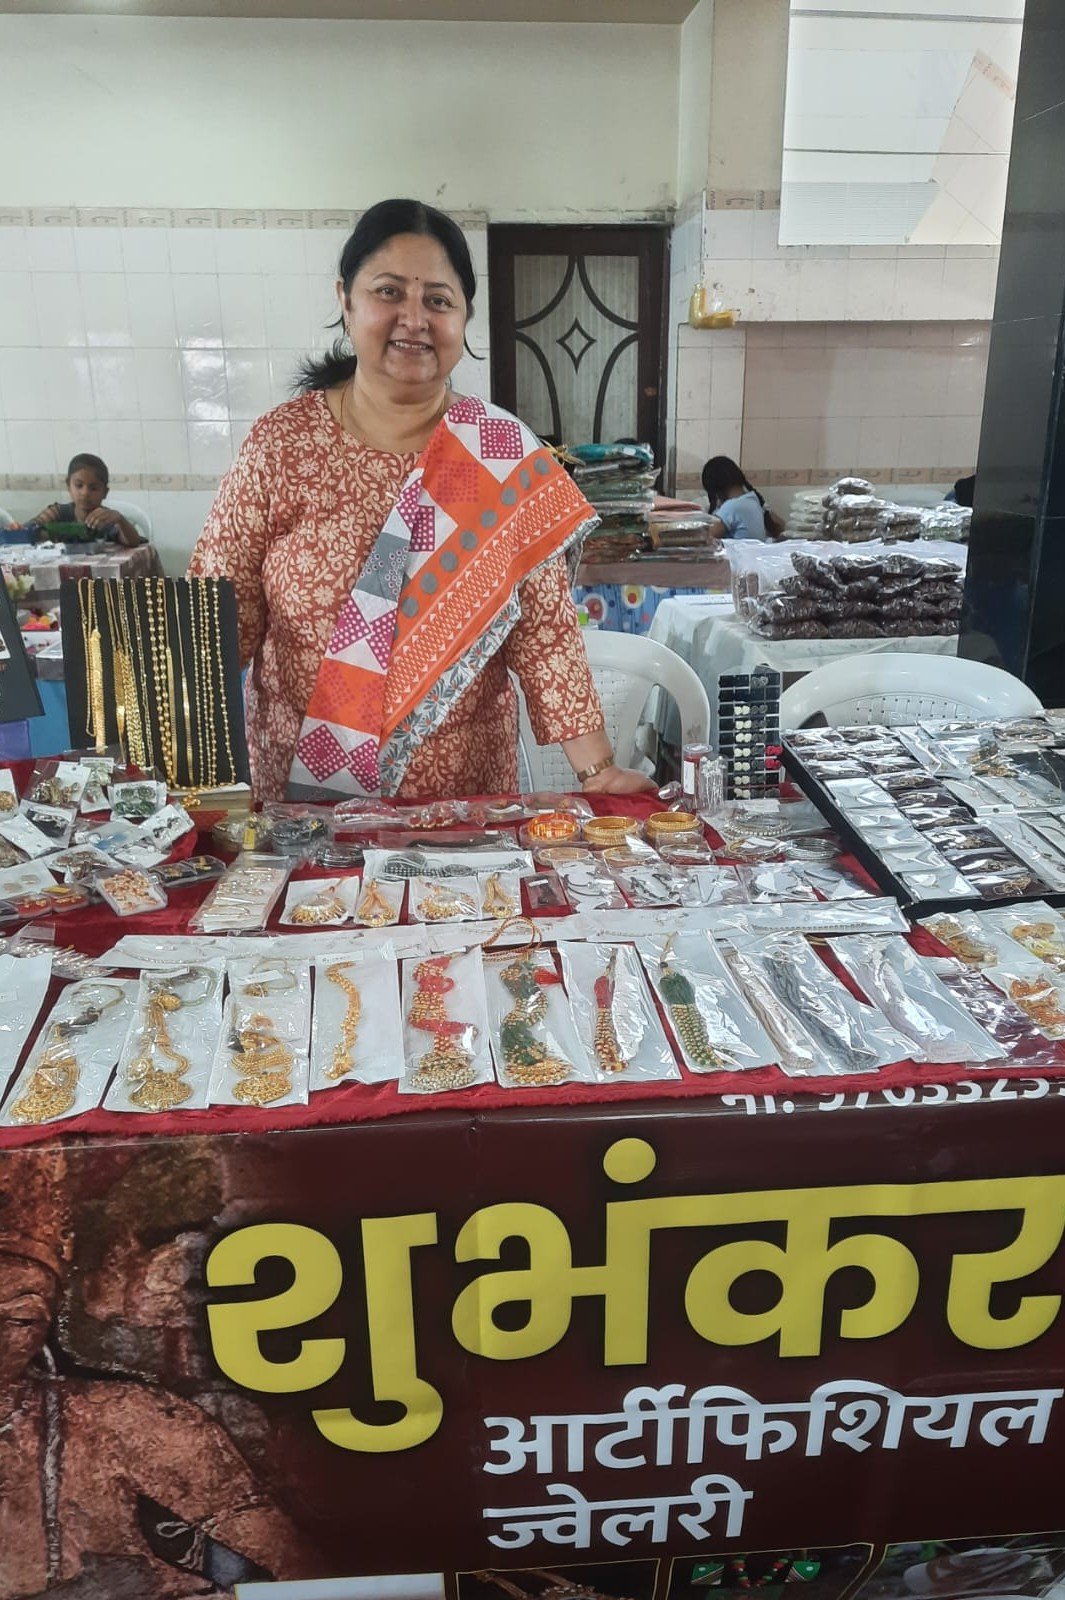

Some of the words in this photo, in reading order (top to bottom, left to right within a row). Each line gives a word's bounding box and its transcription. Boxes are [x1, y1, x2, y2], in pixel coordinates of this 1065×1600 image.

[206, 1138, 1065, 1453] शुभंकर
[482, 1379, 1064, 1475] आर्टीफिशियल
[482, 1473, 754, 1549] ज्वेलरी
